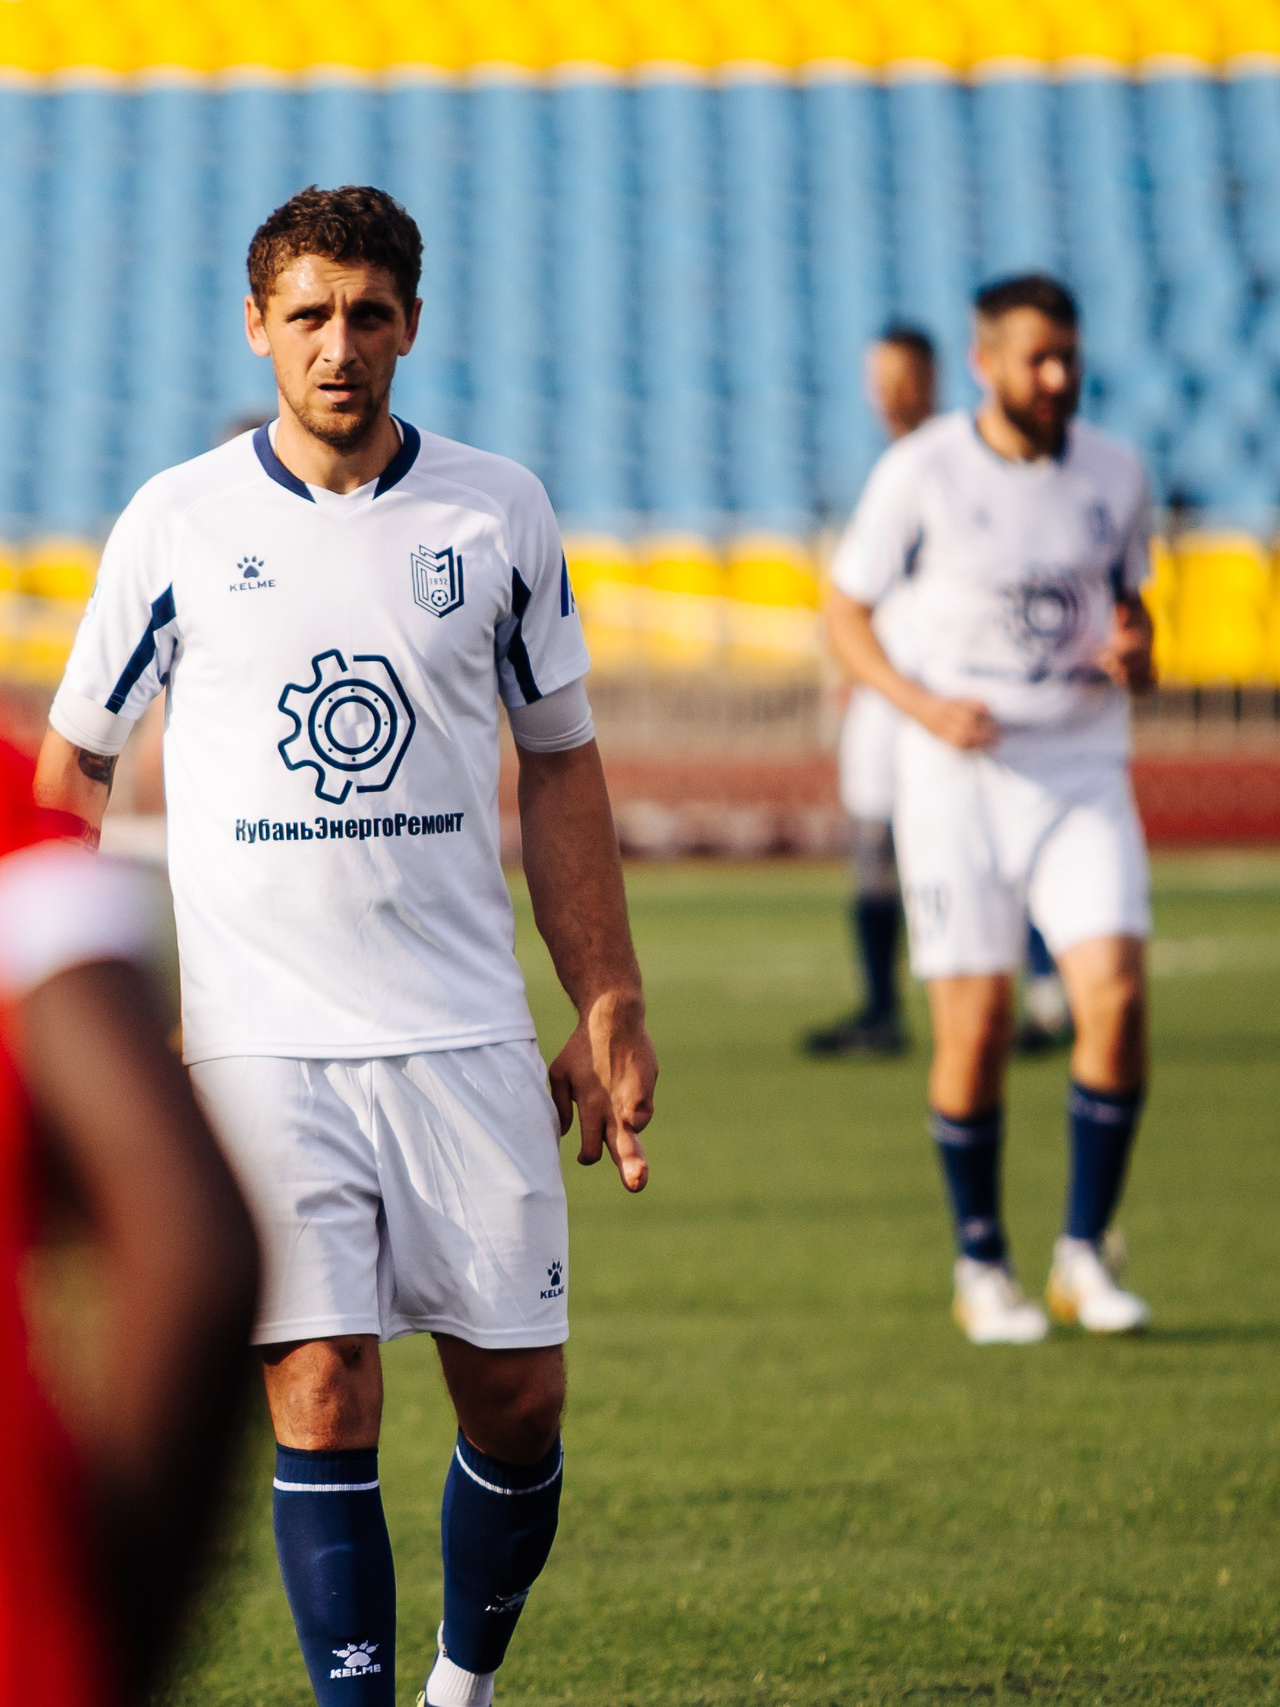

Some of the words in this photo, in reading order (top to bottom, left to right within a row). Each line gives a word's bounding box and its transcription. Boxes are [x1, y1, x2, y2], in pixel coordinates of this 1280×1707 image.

[229, 580, 276, 592] KELME
[235, 812, 464, 844] КубаньЭнергоРемонт
[330, 1663, 381, 1679] KELME
